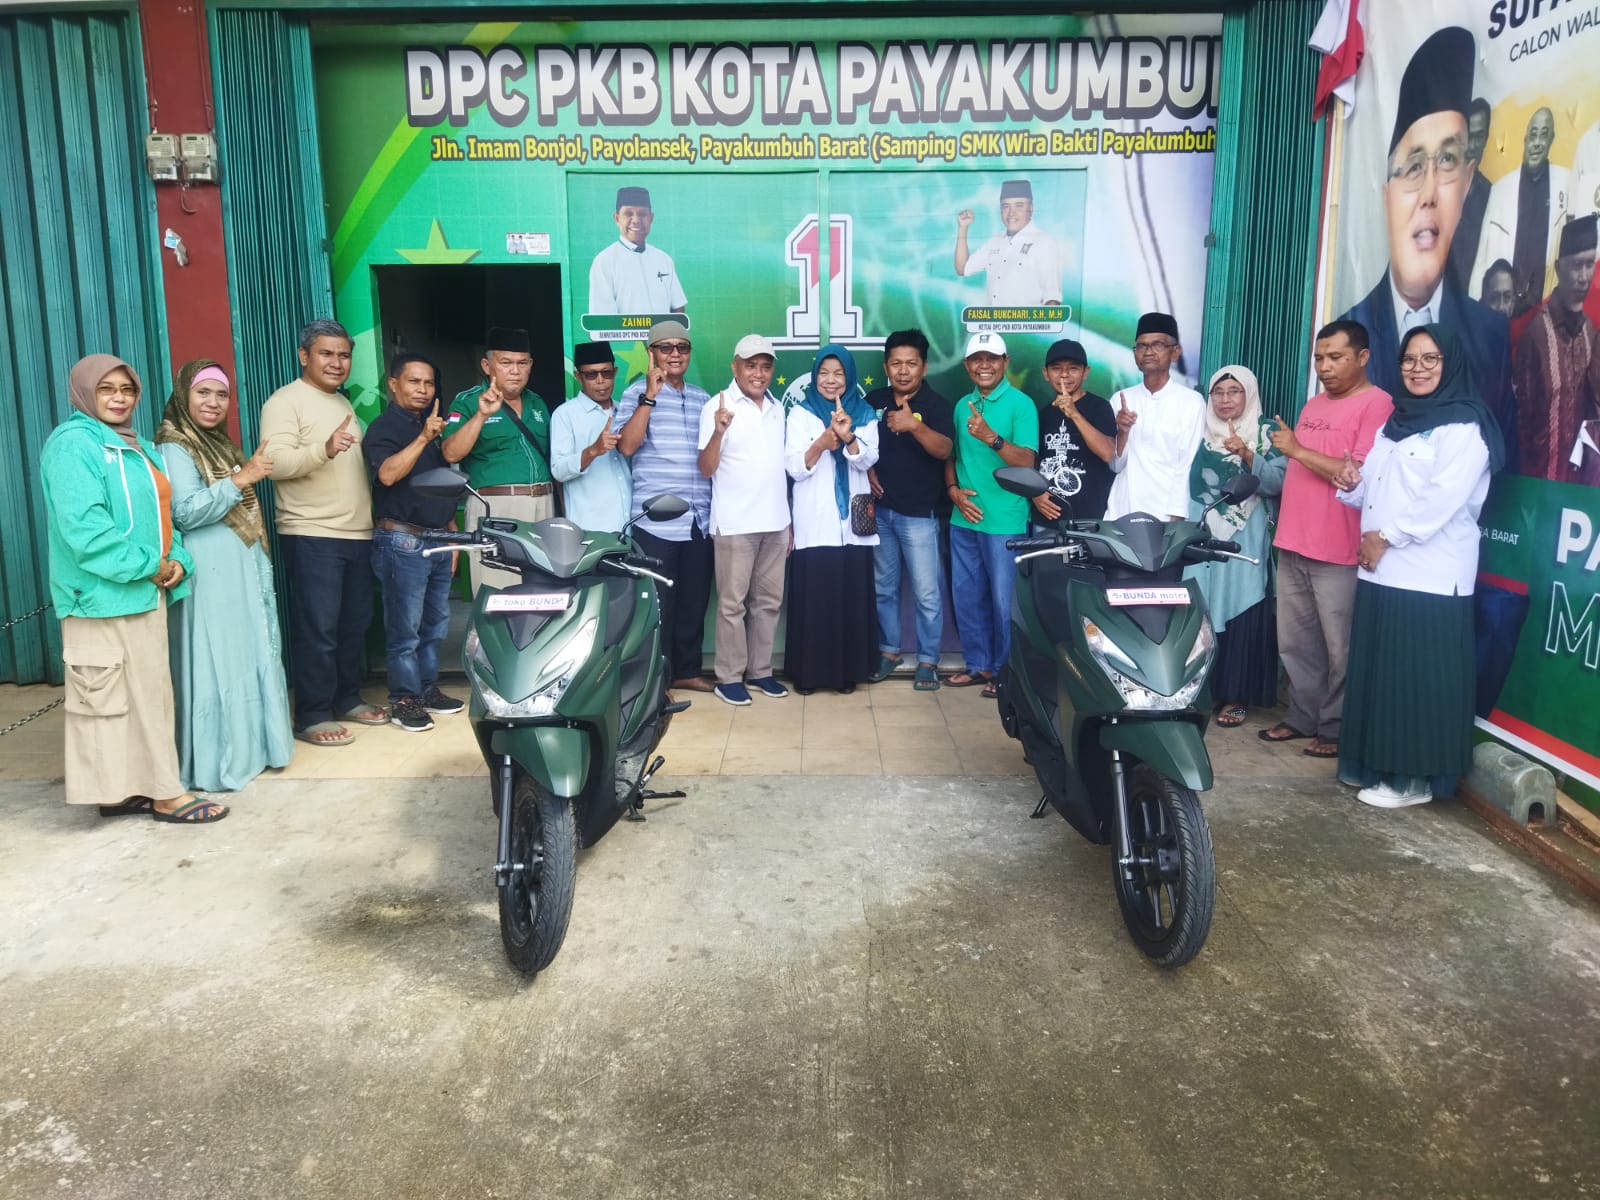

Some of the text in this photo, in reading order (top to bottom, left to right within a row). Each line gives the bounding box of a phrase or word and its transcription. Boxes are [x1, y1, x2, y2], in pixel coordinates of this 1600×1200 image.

[1509, 23, 1561, 62] CALON
[405, 46, 528, 126] DPC
[535, 45, 661, 125] PKB
[670, 43, 831, 125] KOTA
[432, 127, 1216, 164] Jln. Imam Bonjol, Payolansek, Payakumbuh Barat (Samping SMK Wira Bakti Payakumbuh
[785, 213, 863, 338] 1
[622, 317, 652, 327] ZAINIR
[967, 309, 991, 319] FAISAL
[1491, 529, 1520, 545] BARAT
[1123, 592, 1157, 600] BUNDA
